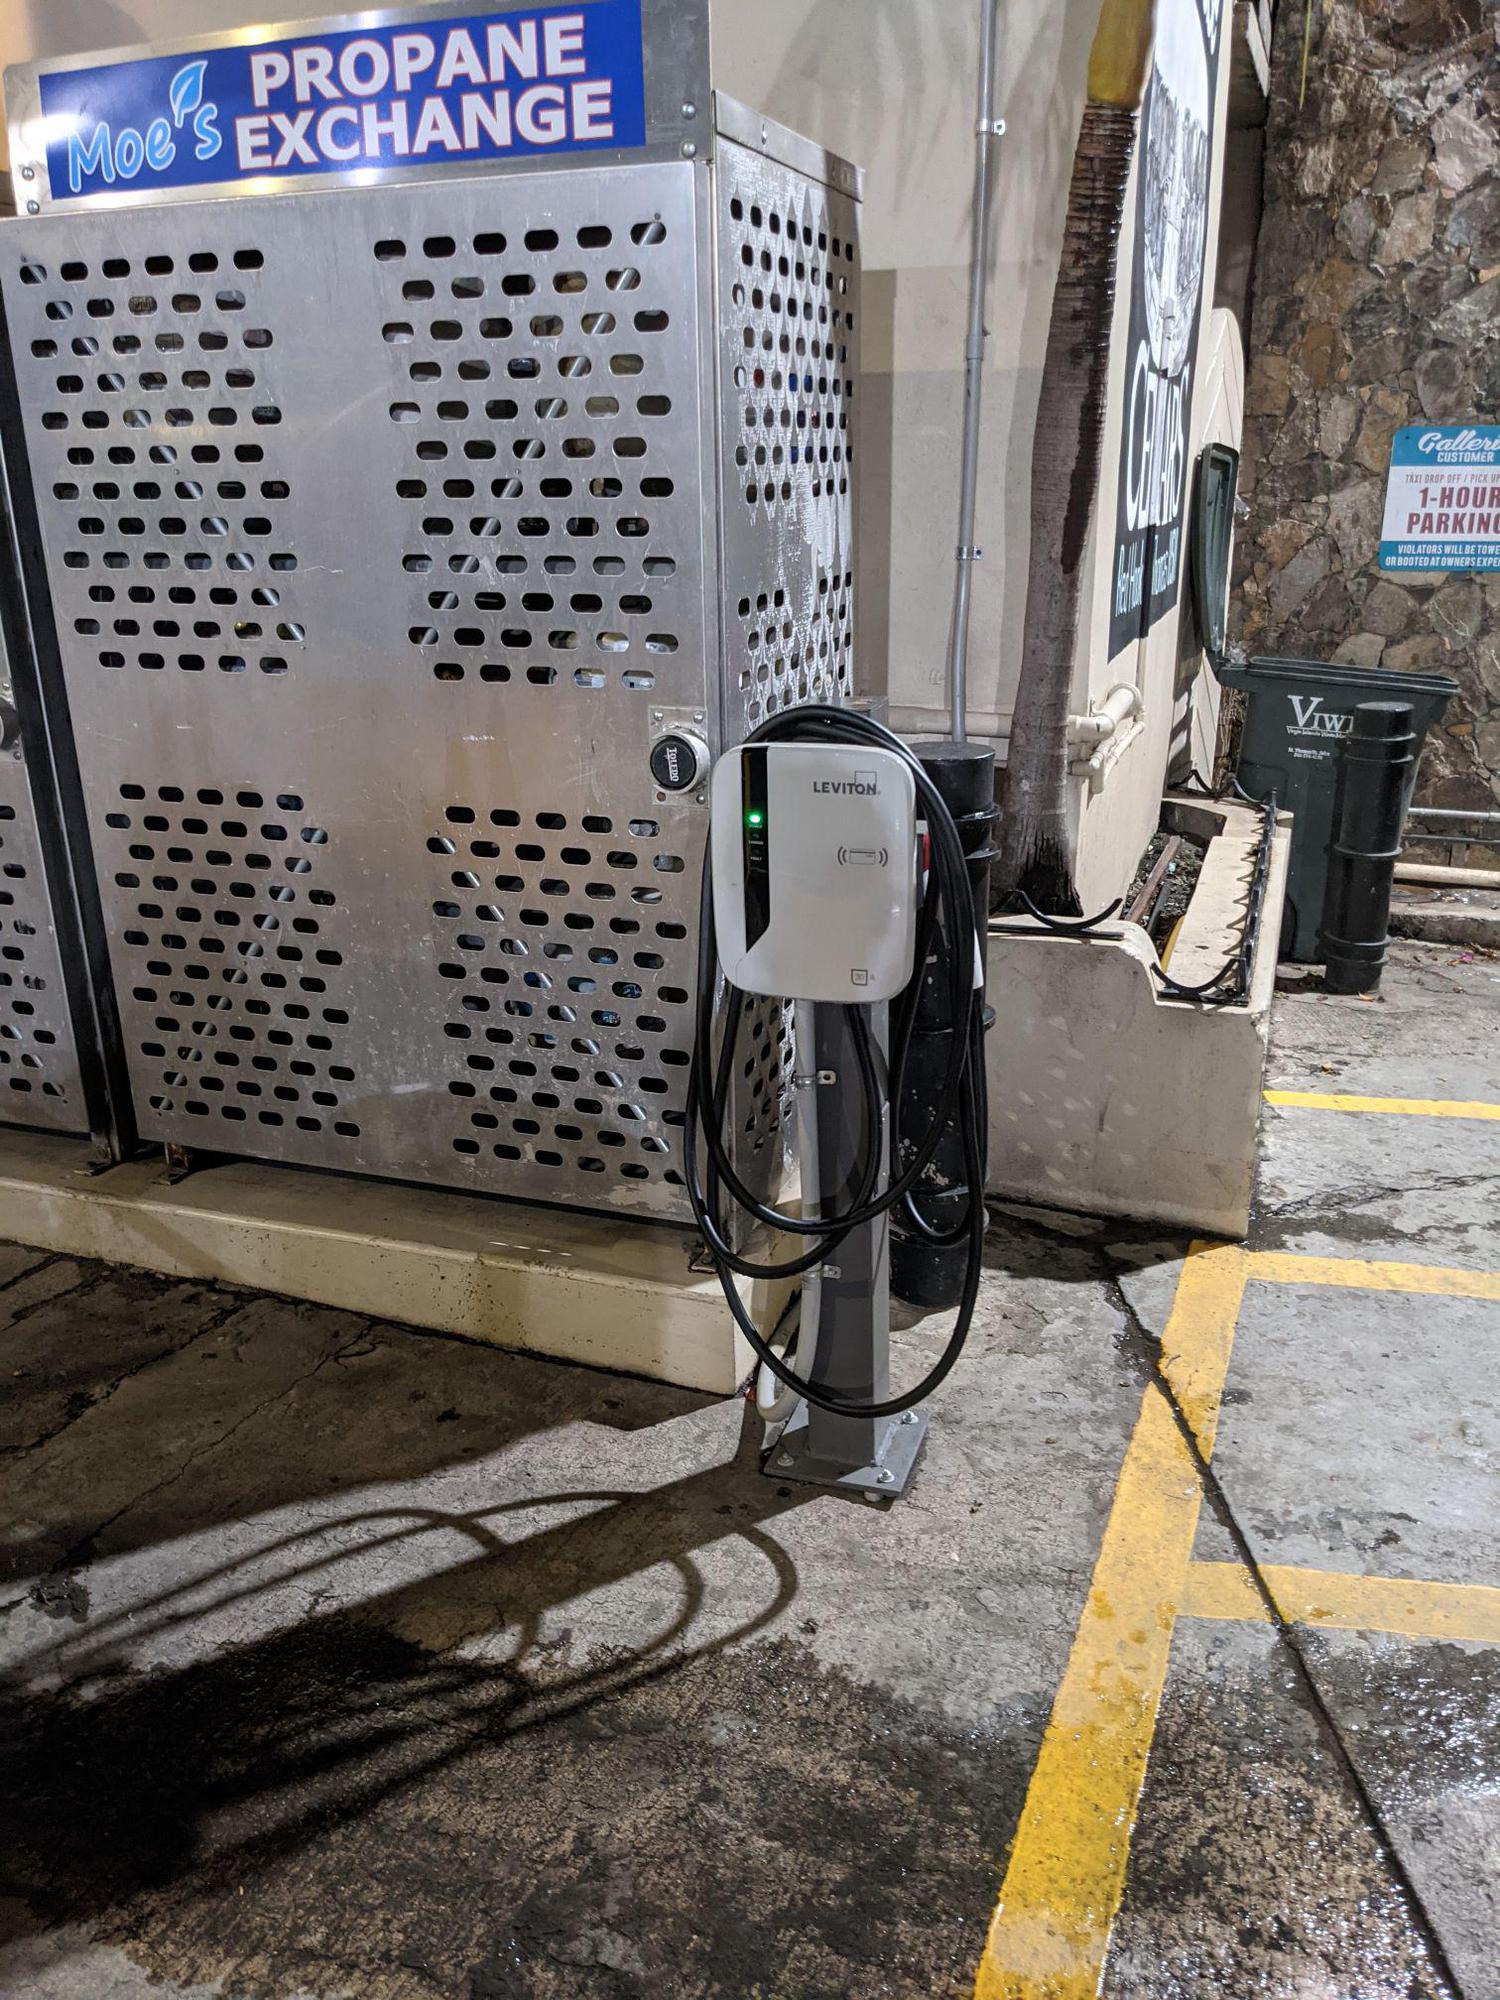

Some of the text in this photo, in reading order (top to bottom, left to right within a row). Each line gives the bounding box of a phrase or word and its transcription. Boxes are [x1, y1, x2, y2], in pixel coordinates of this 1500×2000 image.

[250, 14, 586, 107] PROPANE
[67, 61, 222, 193] Moe's
[234, 79, 614, 171] EXCHANGE
[1126, 340, 1190, 531] CELARS
[1437, 452, 1495, 463] CUSTOMER
[1406, 474, 1423, 484] TAXI
[1424, 474, 1446, 484] DROP
[1446, 475, 1462, 484] OFF
[1470, 475, 1489, 484] PICK
[1419, 486, 1500, 508] 1-HOUR
[1398, 545, 1442, 555] VIOLATORS
[1443, 545, 1464, 555] WILL
[1465, 545, 1476, 555] BE
[1385, 557, 1396, 566] OR
[1397, 557, 1429, 566] BOOTED
[1429, 557, 1441, 566] AT
[1440, 557, 1475, 567] OWNERS
[668, 746, 680, 782] TOLEDO
[813, 781, 877, 796] LEVITON
